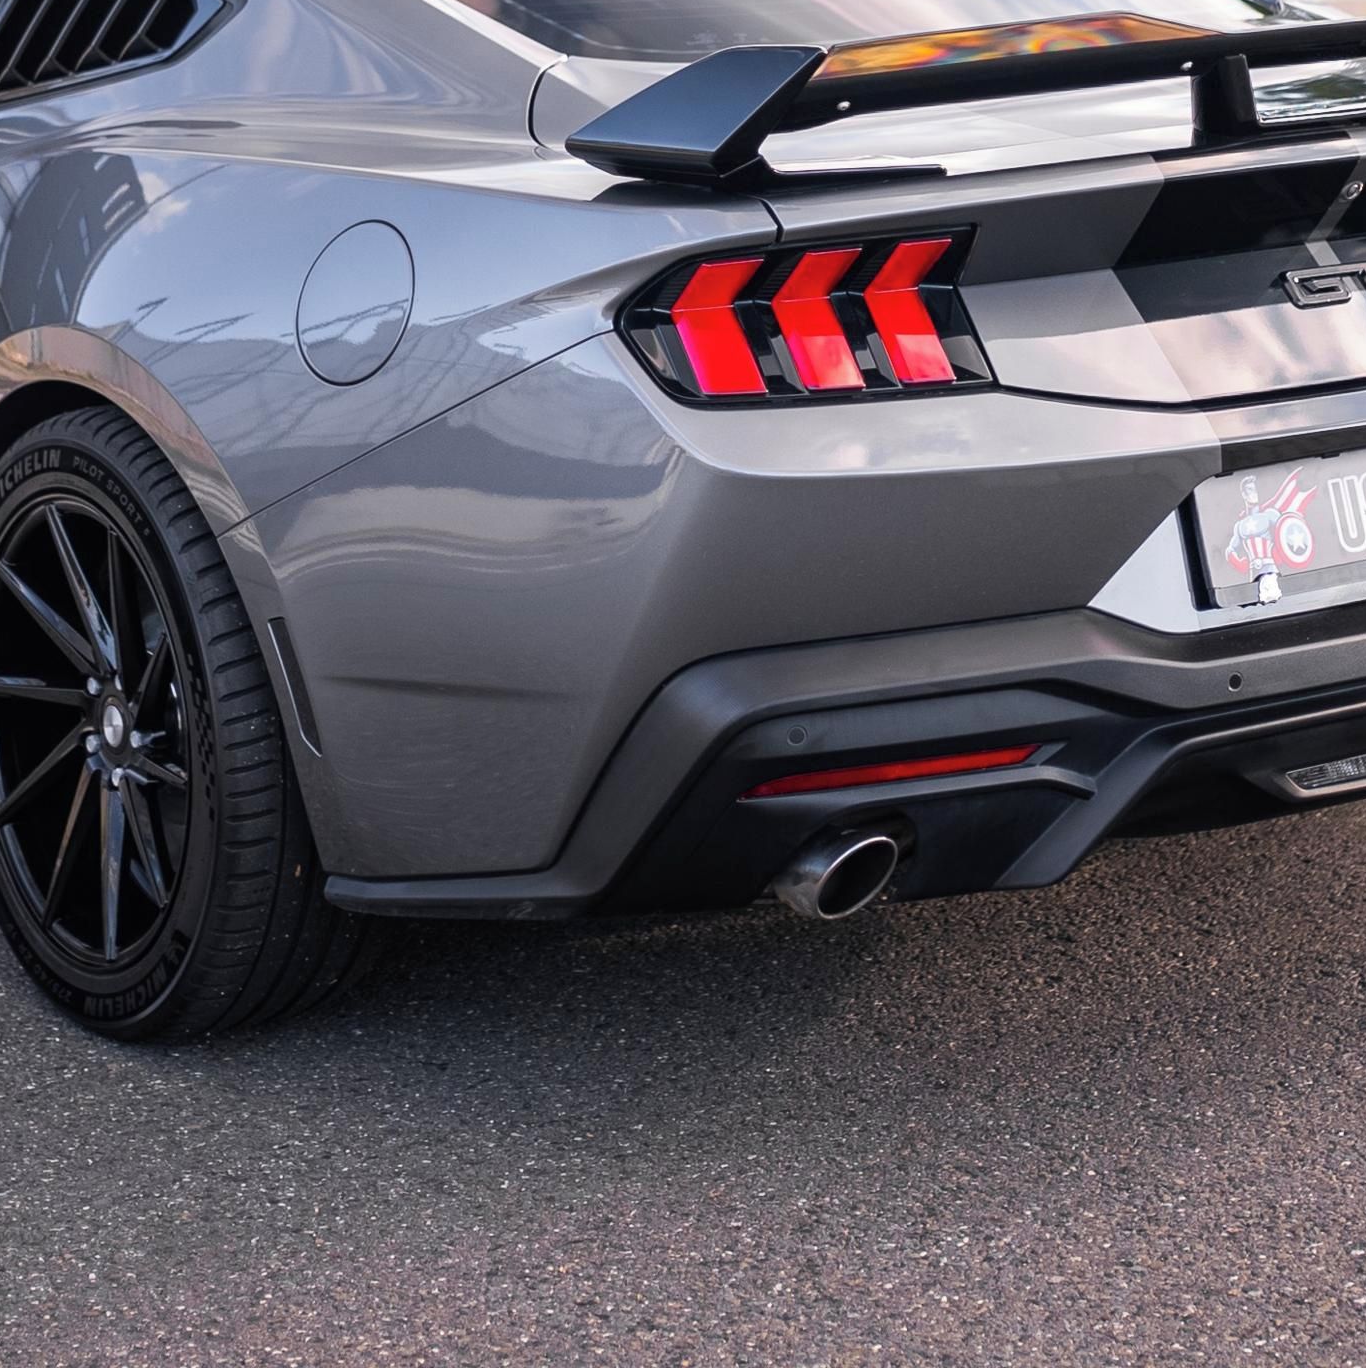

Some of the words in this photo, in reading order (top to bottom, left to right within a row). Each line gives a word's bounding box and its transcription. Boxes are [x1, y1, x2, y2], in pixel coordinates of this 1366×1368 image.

[73, 455, 105, 481] PILOT
[106, 479, 143, 523] SPORT
[84, 961, 167, 1018] MICHELIN
